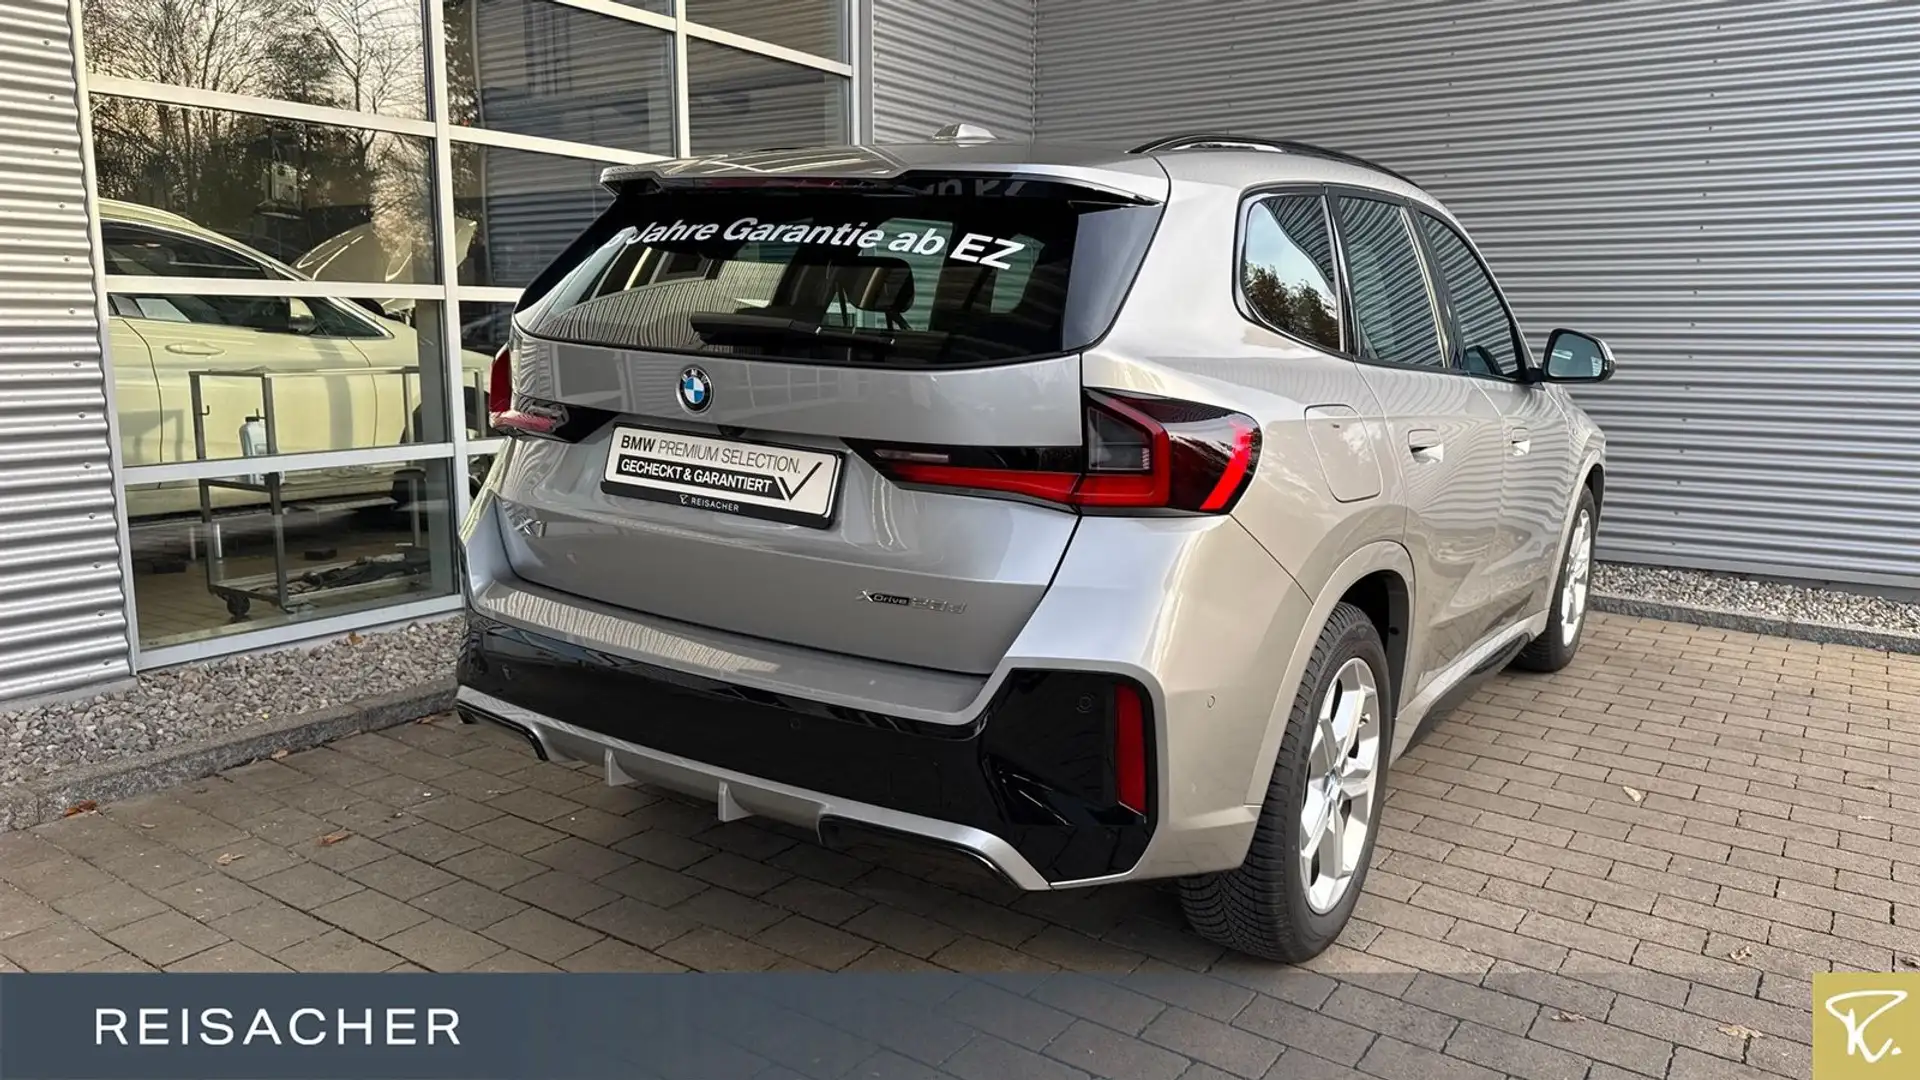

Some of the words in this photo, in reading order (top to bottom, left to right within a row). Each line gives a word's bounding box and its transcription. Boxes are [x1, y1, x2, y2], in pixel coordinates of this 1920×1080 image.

[626, 219, 720, 244] Jahre
[723, 216, 885, 249] Garantie
[888, 228, 946, 256] ab
[949, 232, 1025, 270] EZ
[620, 435, 657, 452] BMW
[657, 440, 720, 462] PREMIUM
[720, 448, 801, 475] SELECTION.
[620, 458, 684, 480] GECHECKT
[682, 468, 693, 481] &
[693, 469, 773, 493] GARANTIERT
[690, 496, 740, 513] REISACHER
